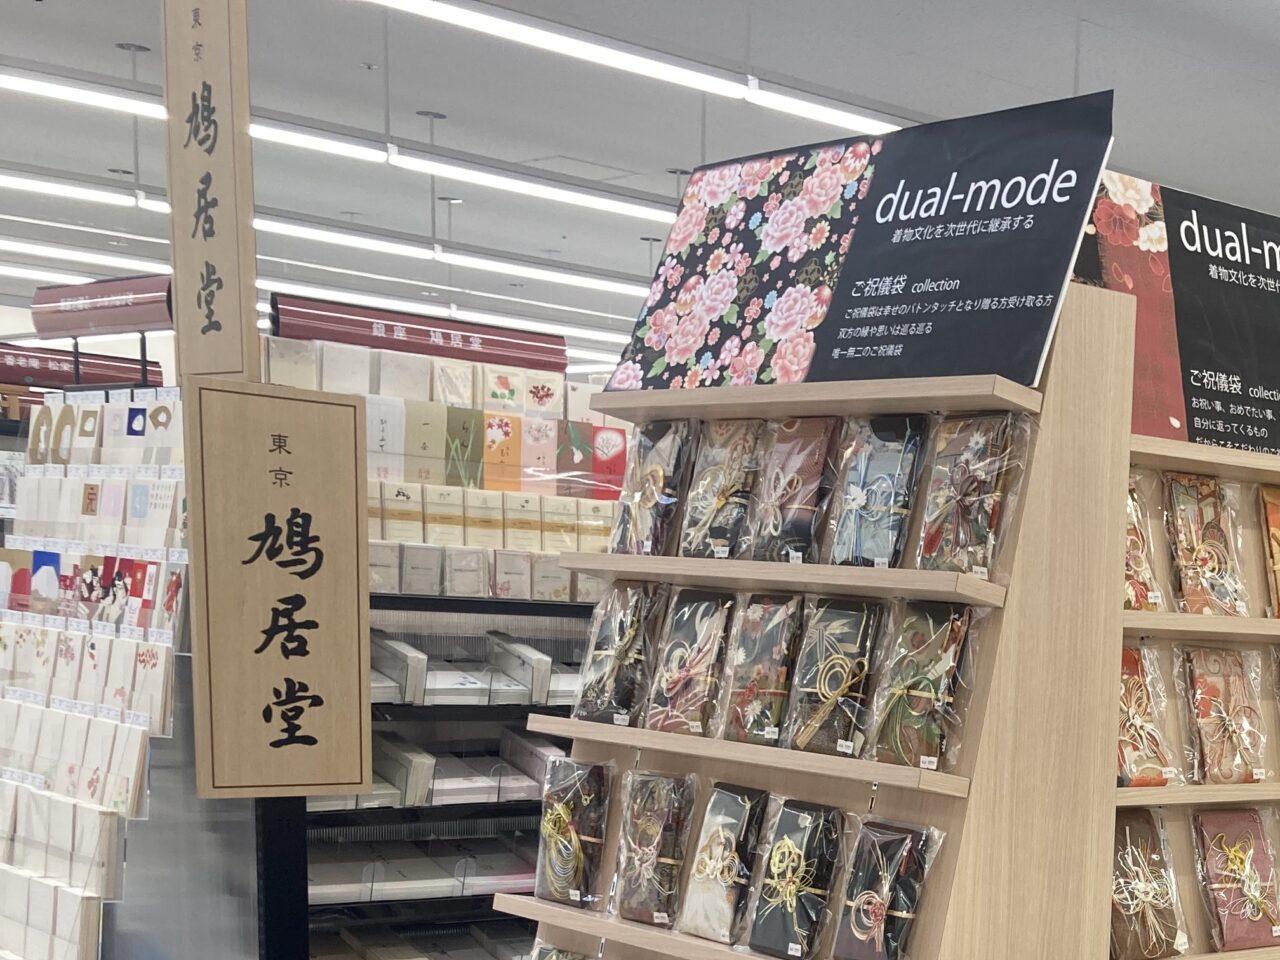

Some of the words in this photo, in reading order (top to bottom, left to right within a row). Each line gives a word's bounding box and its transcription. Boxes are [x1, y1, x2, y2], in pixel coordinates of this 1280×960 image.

[190, 7, 203, 62] 東京
[183, 81, 223, 335] 鳩居堂
[875, 158, 1078, 224] dual-mode
[891, 214, 1034, 243] 着物文化を次世代に継承する
[851, 274, 907, 297] ご祝儀袋
[911, 277, 961, 294] collection
[372, 322, 407, 340] 銀座
[430, 330, 483, 350] 鳩居堂
[1190, 369, 1242, 395] ご祝儀袋
[268, 433, 294, 489] 東京
[241, 507, 325, 749] 鳩居堂
